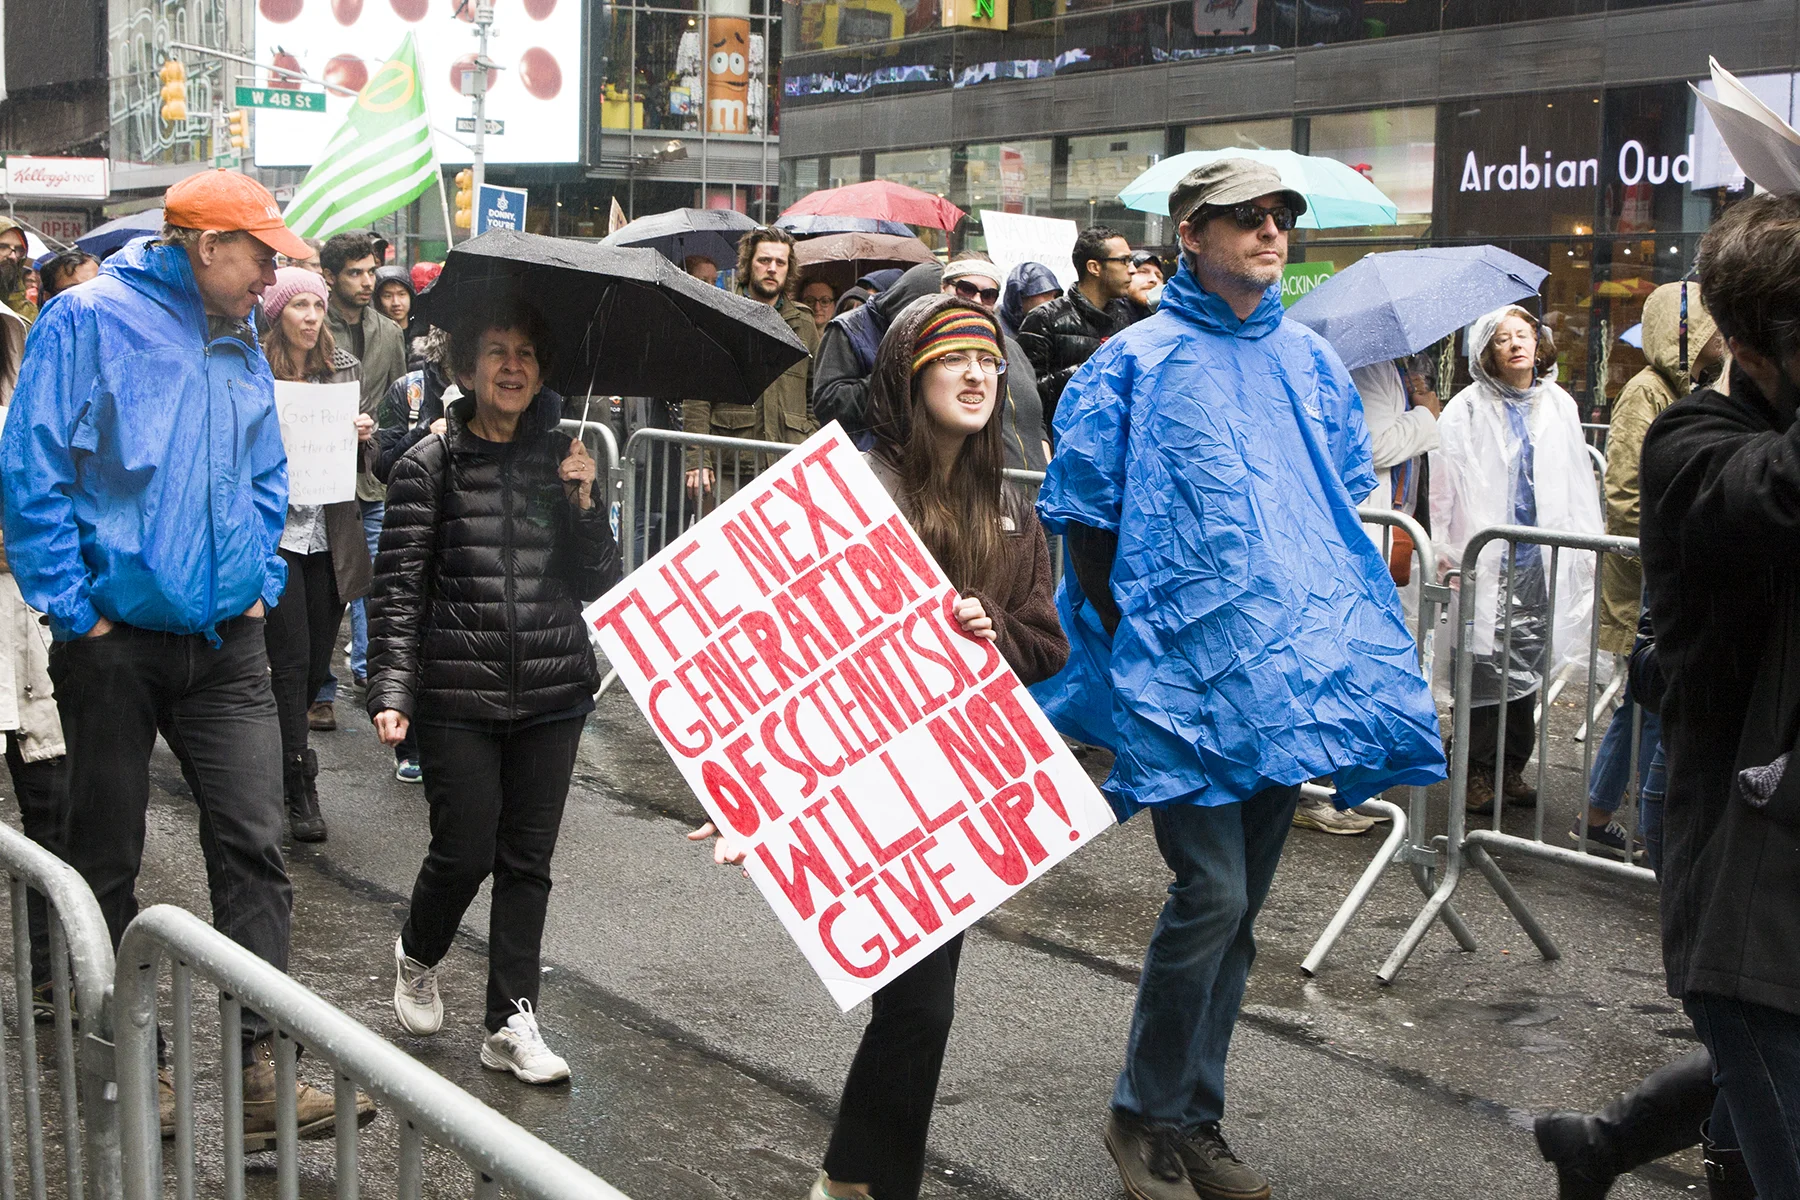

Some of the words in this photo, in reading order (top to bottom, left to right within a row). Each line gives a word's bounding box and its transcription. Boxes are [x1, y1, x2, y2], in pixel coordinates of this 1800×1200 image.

[252, 91, 265, 105] W
[269, 92, 292, 106] 48
[295, 94, 312, 108] St
[710, 98, 745, 131] m
[14, 167, 70, 187] Kellogg's
[72, 174, 95, 183] NYC
[1459, 145, 1598, 192] Arabian
[1618, 134, 1695, 187] Oud
[41, 221, 80, 238] OPEN
[487, 218, 515, 231] YOU'RE
[488, 208, 516, 221] DONNY,
[282, 403, 315, 424] Got
[594, 540, 742, 682] THE
[719, 436, 872, 598] NEXT
[648, 513, 942, 759] GENERATION
[700, 734, 786, 838] OF
[753, 751, 970, 921] WILL
[929, 671, 1056, 804] NOT
[816, 835, 977, 980] GIVE
[959, 768, 1081, 888] UP!
